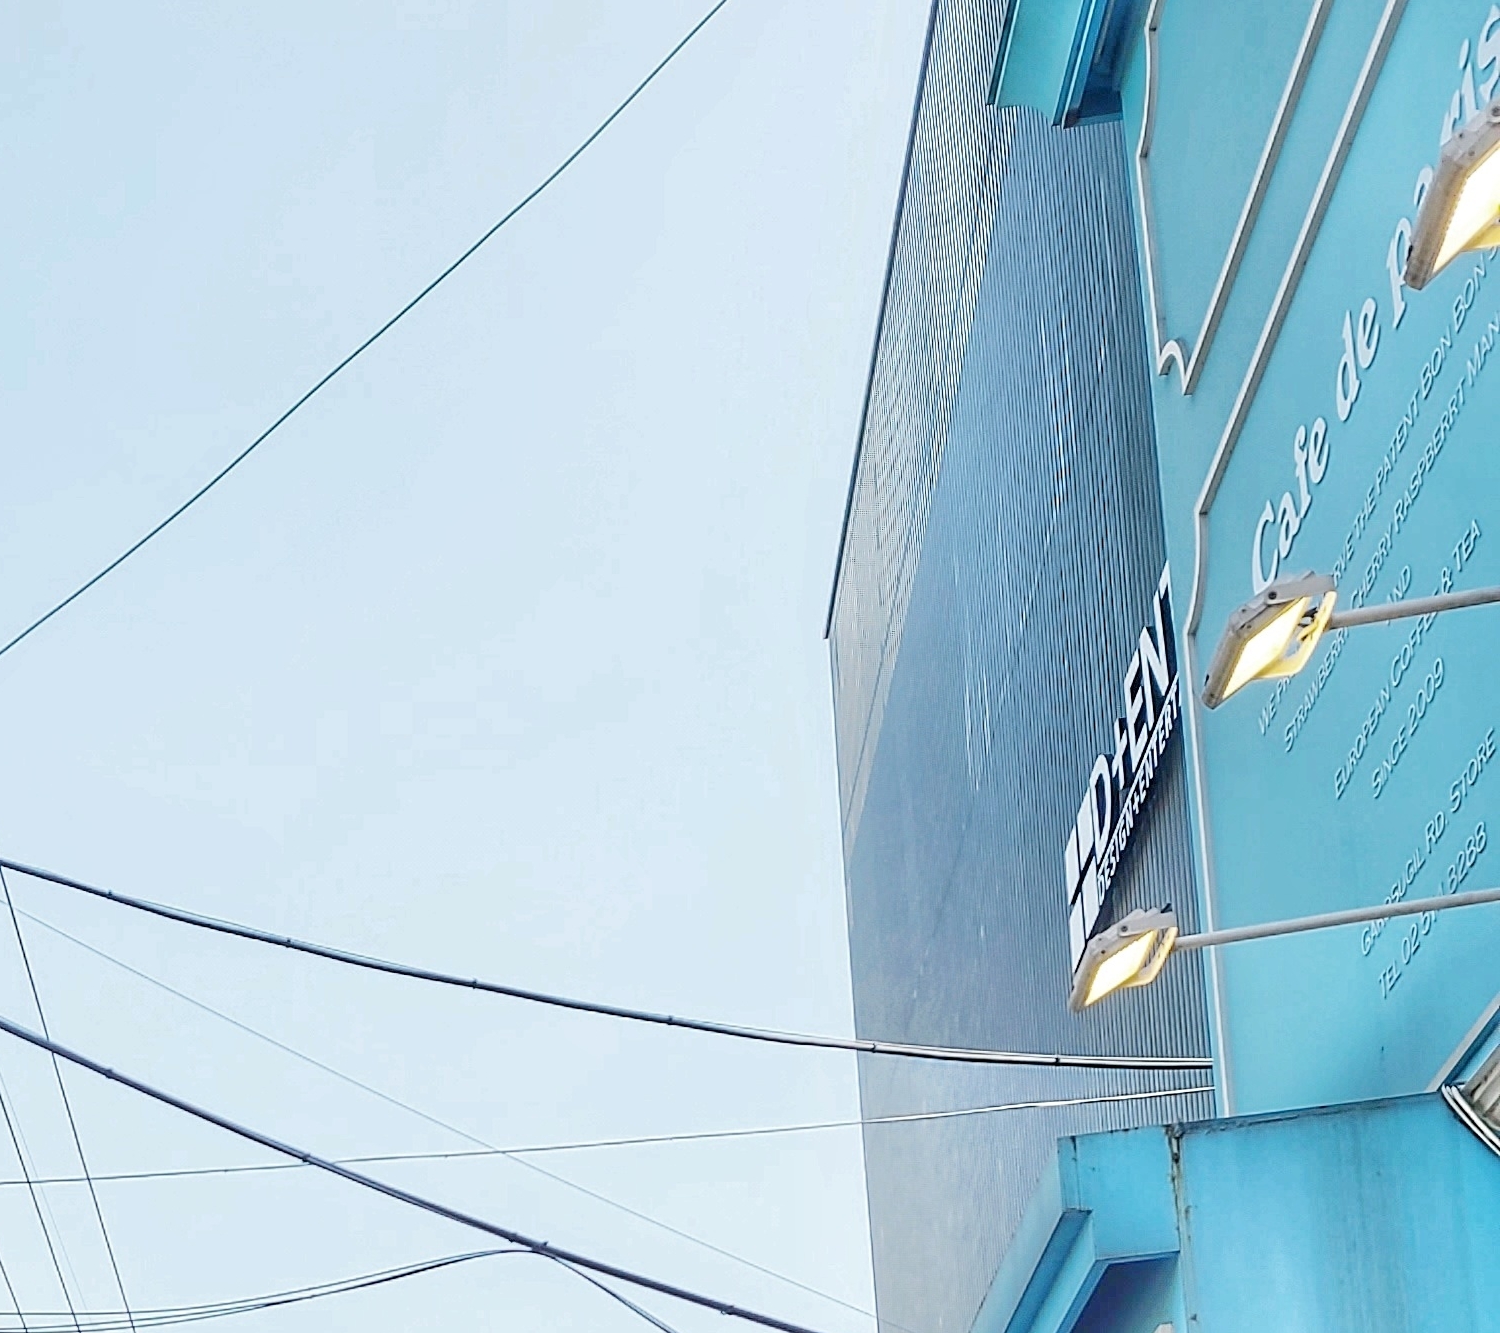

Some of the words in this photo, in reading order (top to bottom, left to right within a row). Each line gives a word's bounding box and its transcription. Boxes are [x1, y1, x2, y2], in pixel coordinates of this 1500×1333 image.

[1251, 417, 1329, 596] Cafe
[1336, 297, 1380, 421] de
[1352, 487, 1375, 543] THE
[1375, 387, 1420, 498] PATENT
[1420, 324, 1453, 401] BON
[1452, 251, 1487, 334] BON
[1334, 683, 1391, 800] EUROPEAN
[1452, 519, 1482, 573] TEA
[1371, 728, 1409, 800] SINCE
[1407, 656, 1446, 738] 2009
[1425, 809, 1449, 853] RD.
[1449, 726, 1498, 814] STORE
[1378, 960, 1402, 1000] TEL
[1401, 923, 1421, 965] 02
